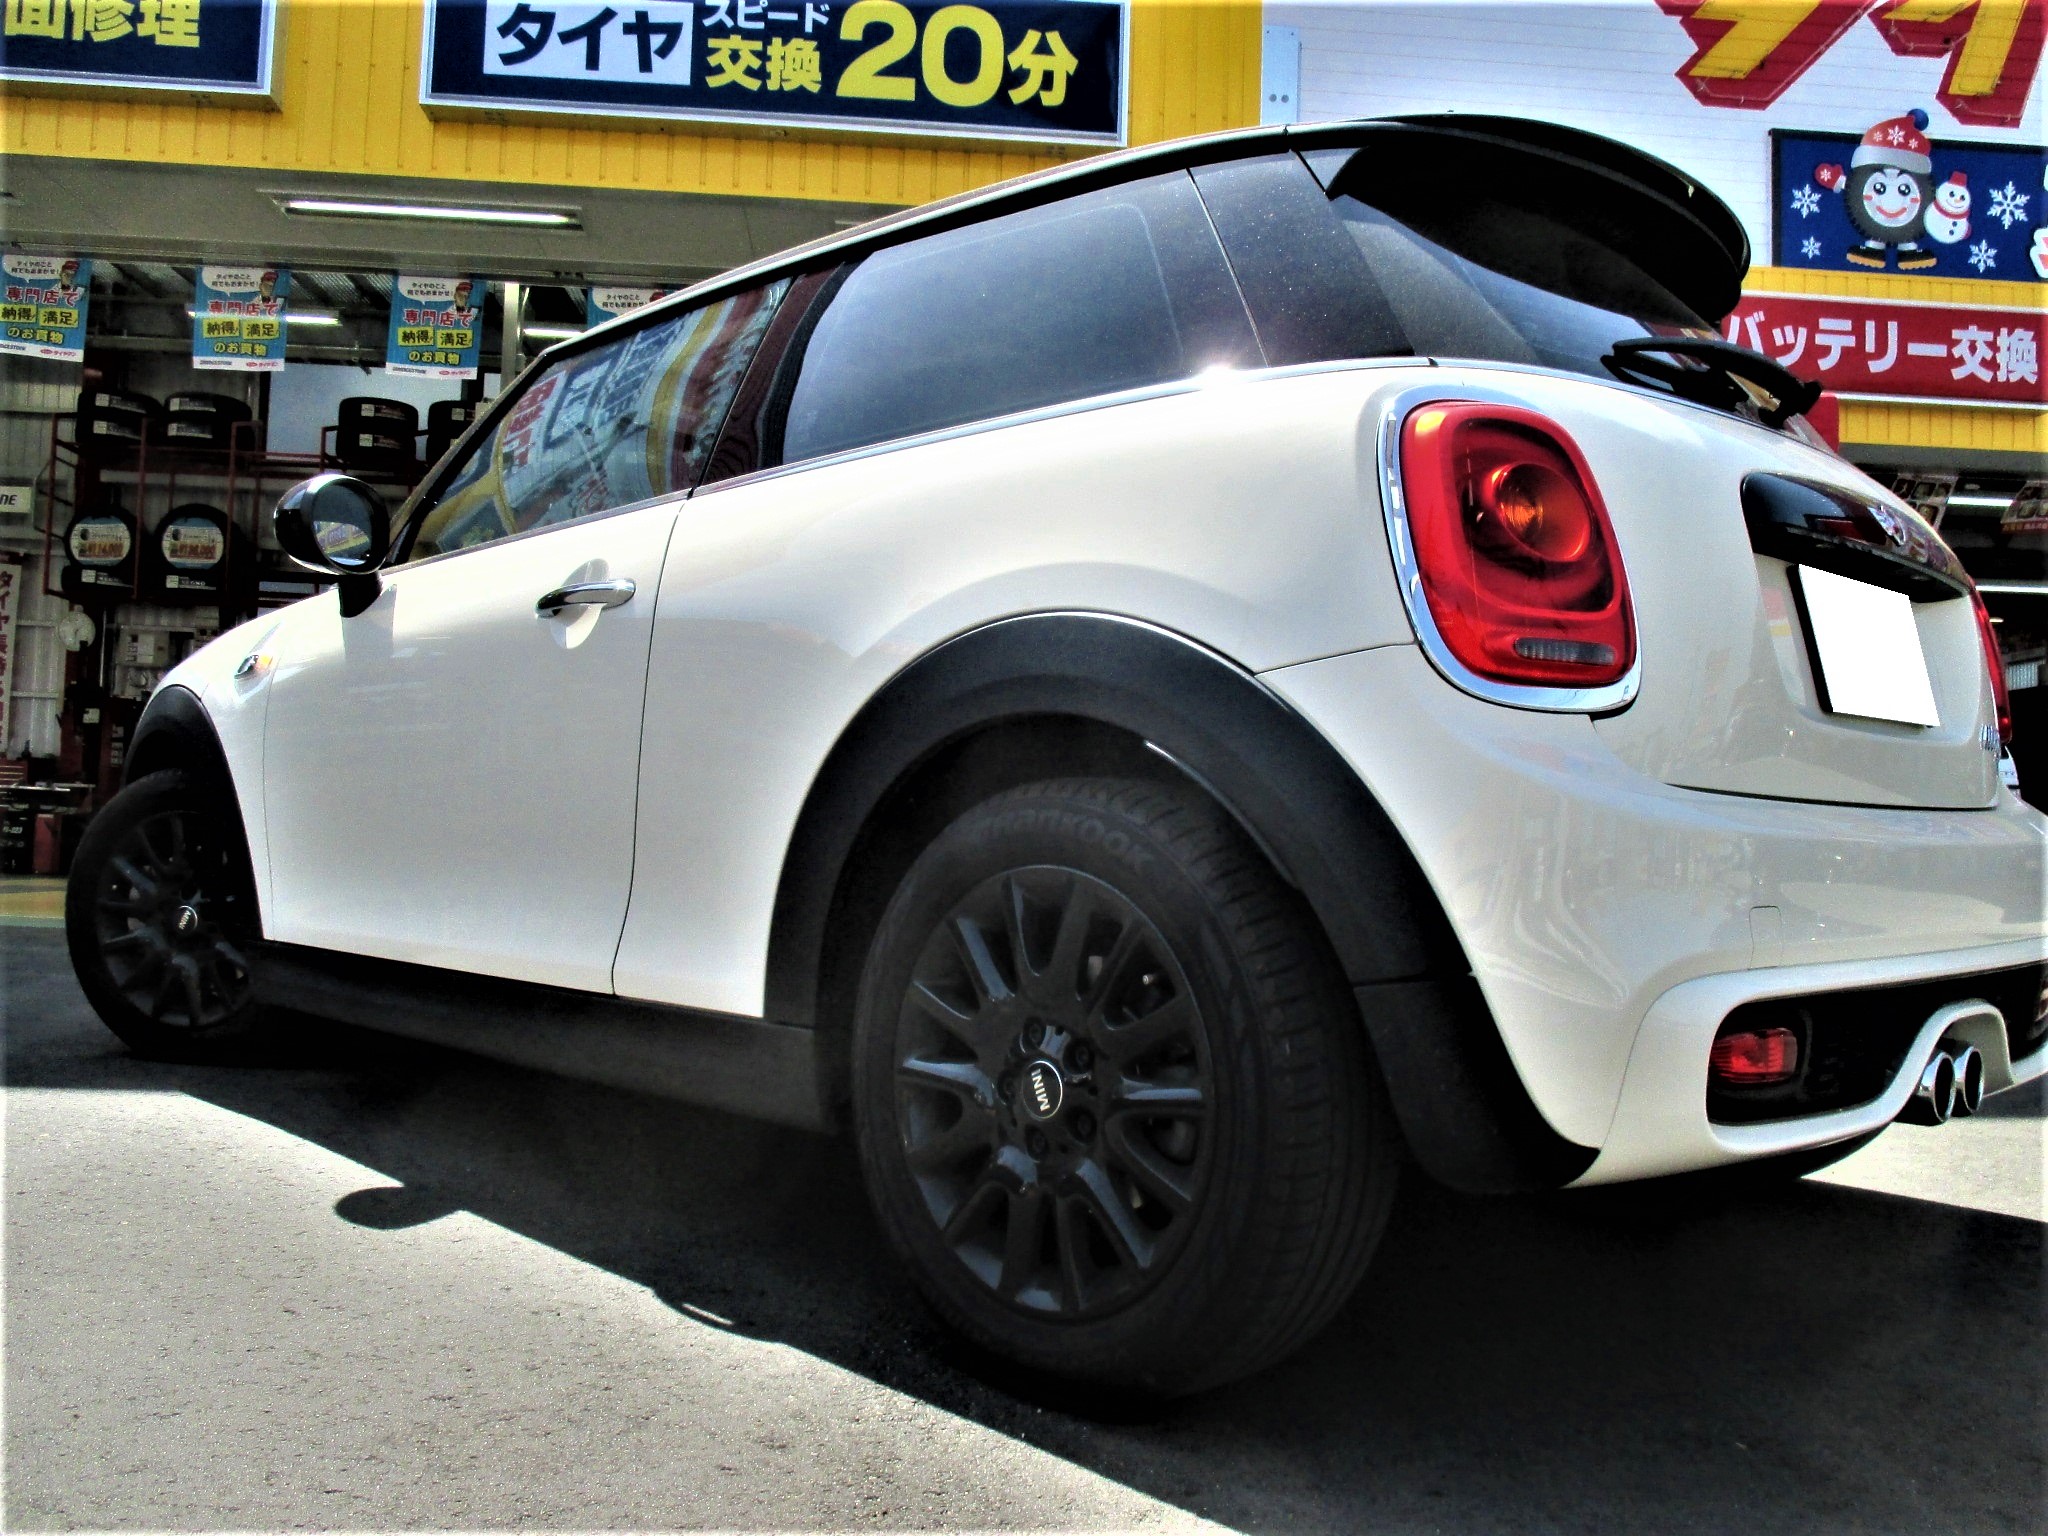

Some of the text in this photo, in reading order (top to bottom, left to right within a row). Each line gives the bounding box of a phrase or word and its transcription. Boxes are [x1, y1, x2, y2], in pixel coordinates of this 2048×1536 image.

[497, 3, 684, 73] タイヤ
[702, 0, 830, 33] スピード
[1726, 311, 2038, 385] バッテリー交換
[1031, 1068, 1050, 1112] MINI
